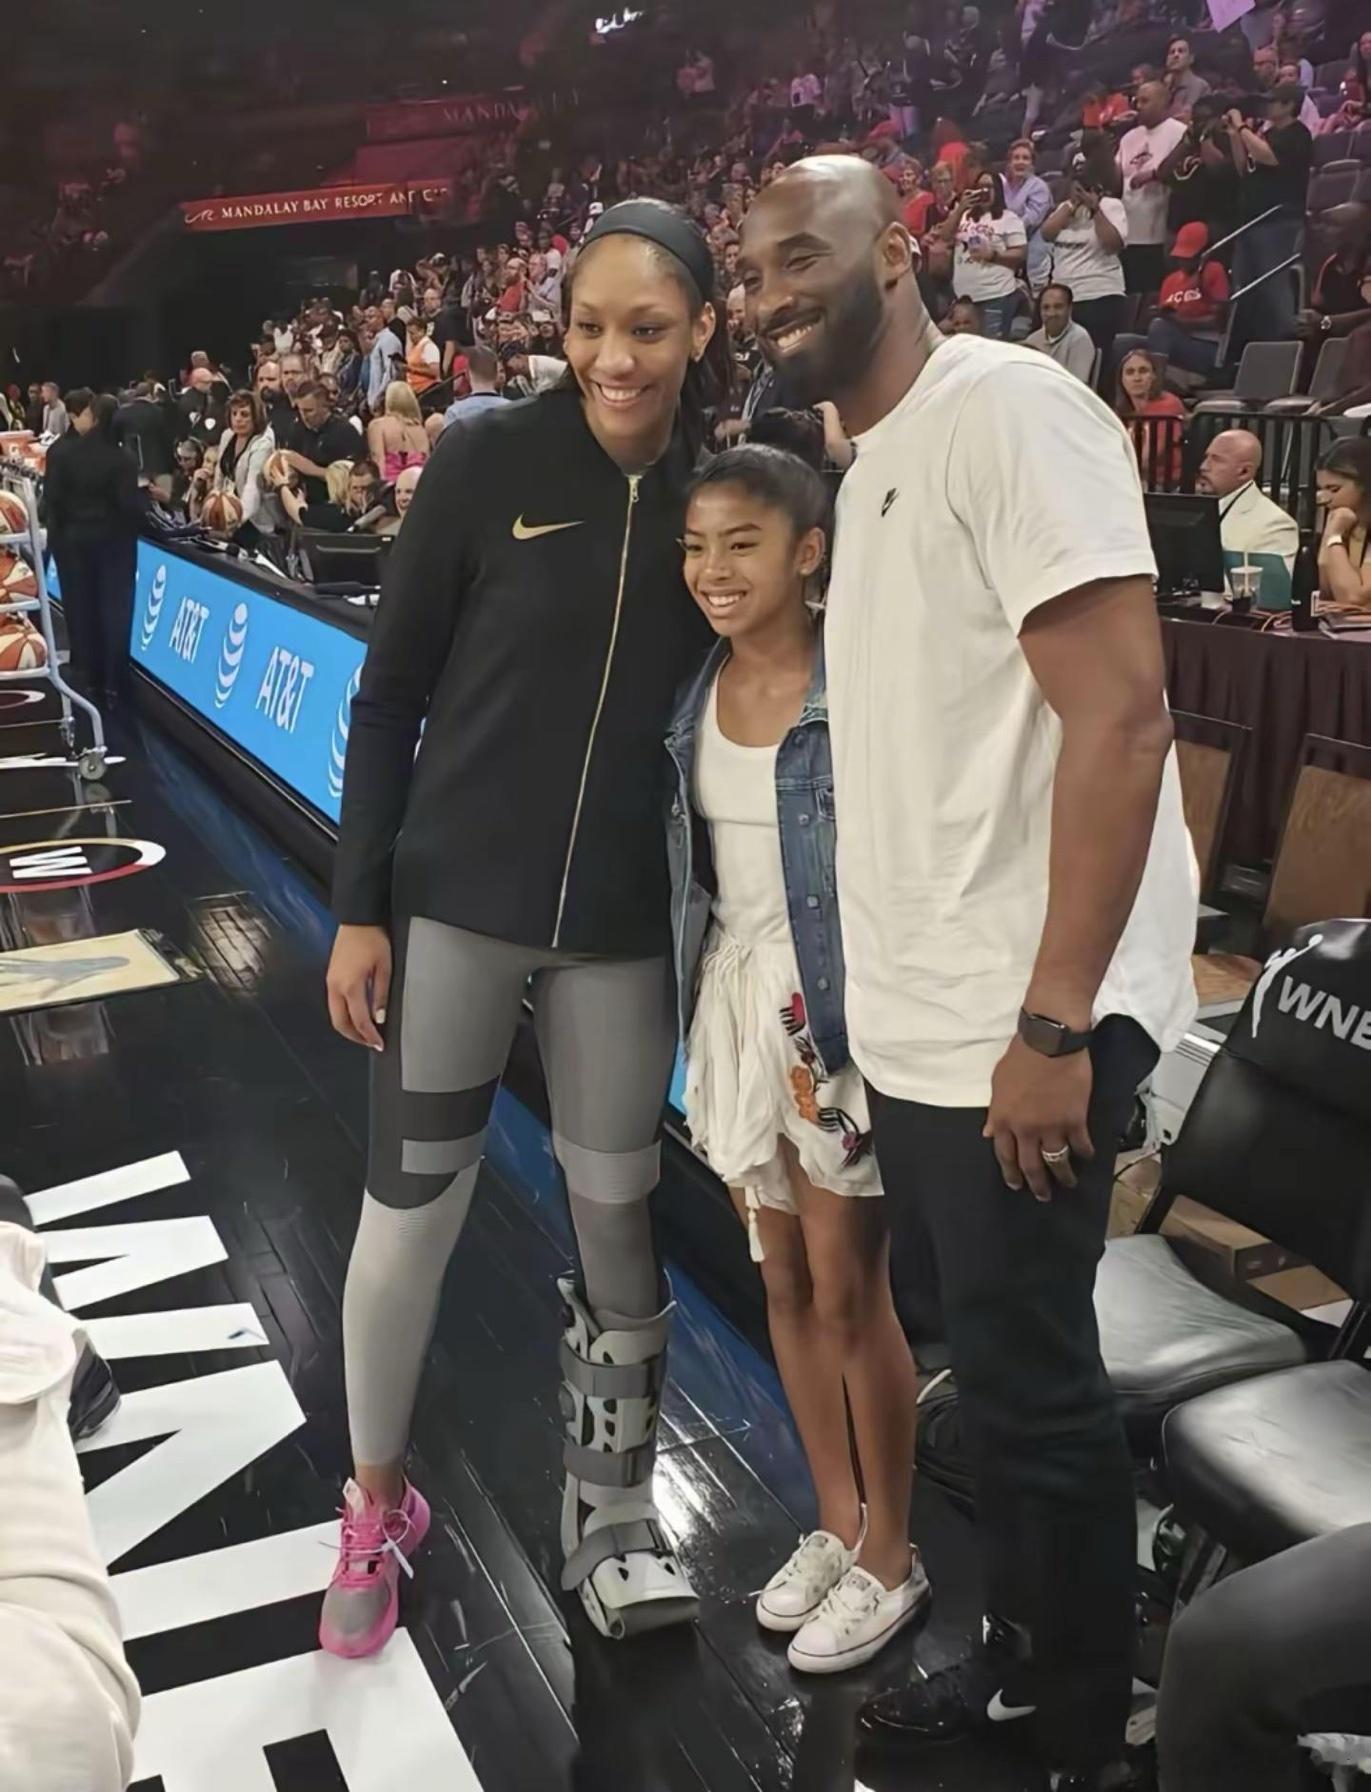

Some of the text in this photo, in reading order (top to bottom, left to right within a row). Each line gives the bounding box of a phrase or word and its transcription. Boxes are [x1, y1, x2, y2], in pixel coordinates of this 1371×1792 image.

[222, 201, 298, 218] MANDALAY
[303, 199, 328, 212] BAY
[335, 193, 383, 208] RESORT
[169, 597, 314, 734] AT&T AT&T
